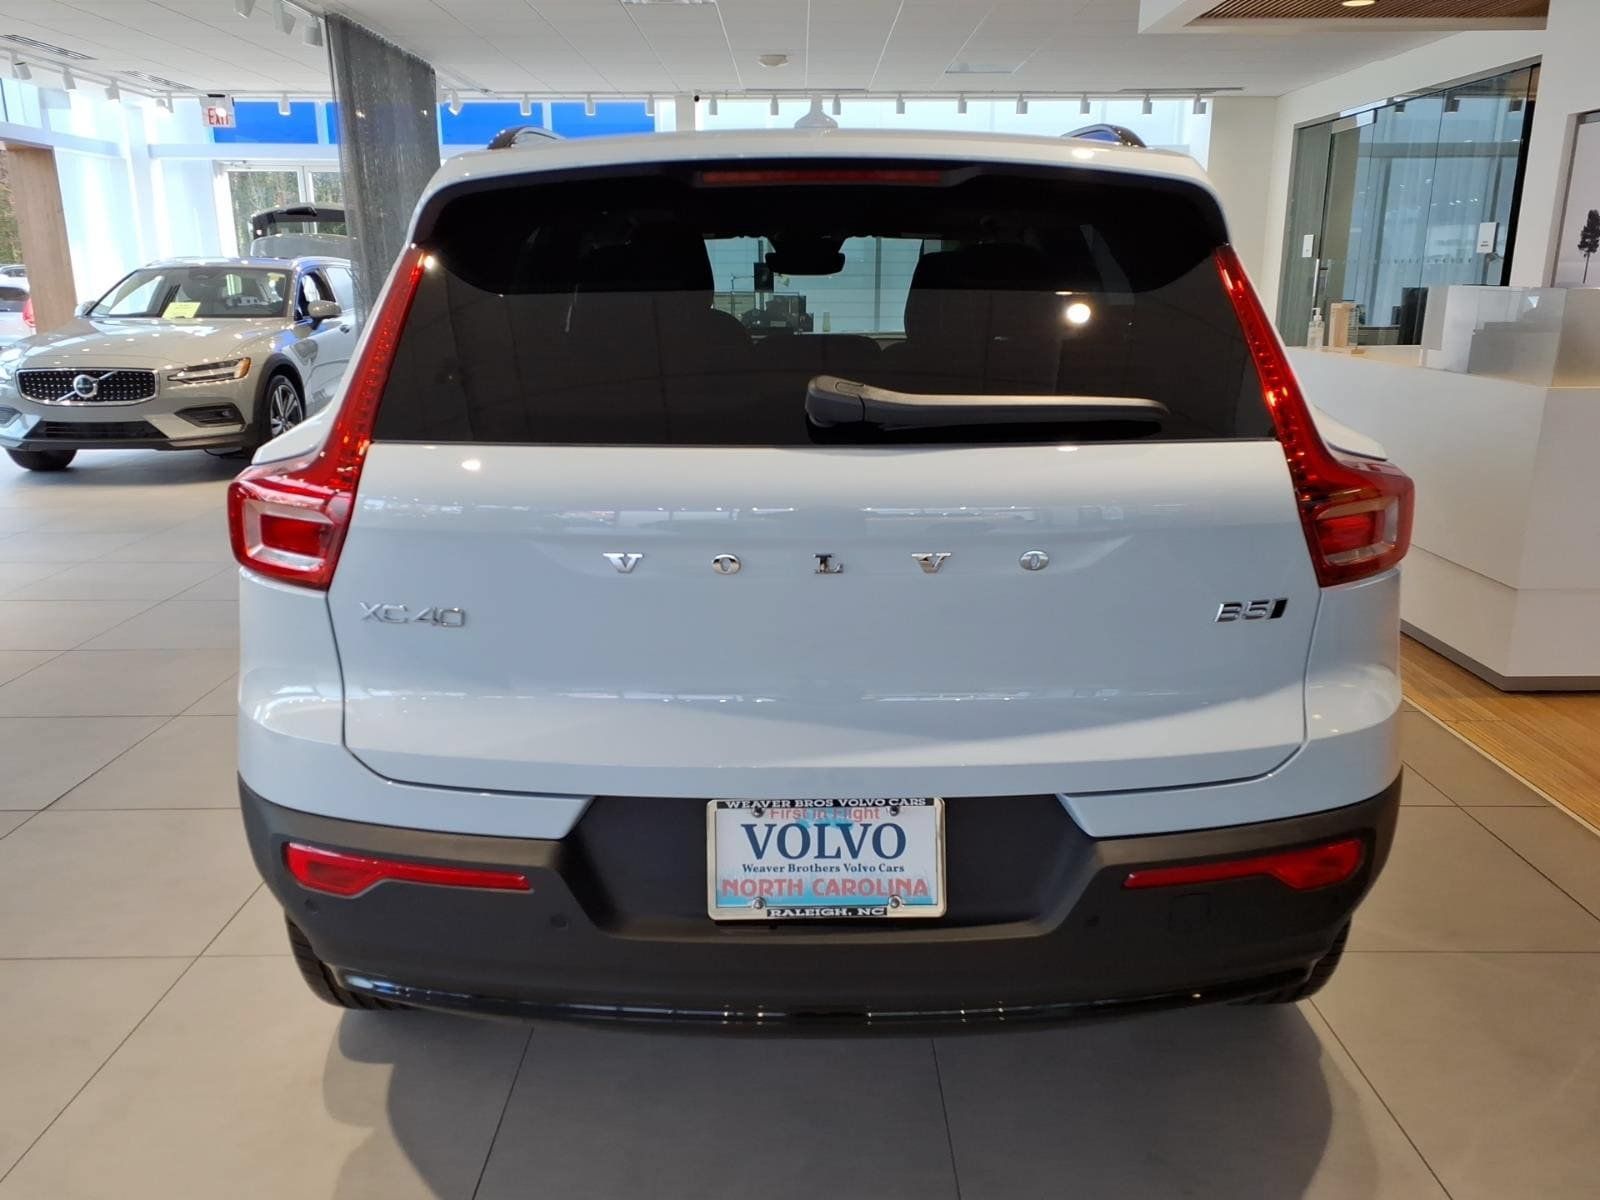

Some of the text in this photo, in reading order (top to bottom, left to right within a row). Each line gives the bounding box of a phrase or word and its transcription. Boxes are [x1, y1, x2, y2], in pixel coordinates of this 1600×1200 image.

[602, 550, 1050, 575] VOLVO
[725, 797, 927, 809] WEAVER BROS VOLVO CARS
[769, 807, 880, 822] First in Flight
[740, 823, 907, 860] VOLVO
[742, 863, 905, 873] Weaver Brothers Volvo Cars
[721, 878, 929, 898] NORTH CAROLINA
[857, 907, 885, 916] NC
